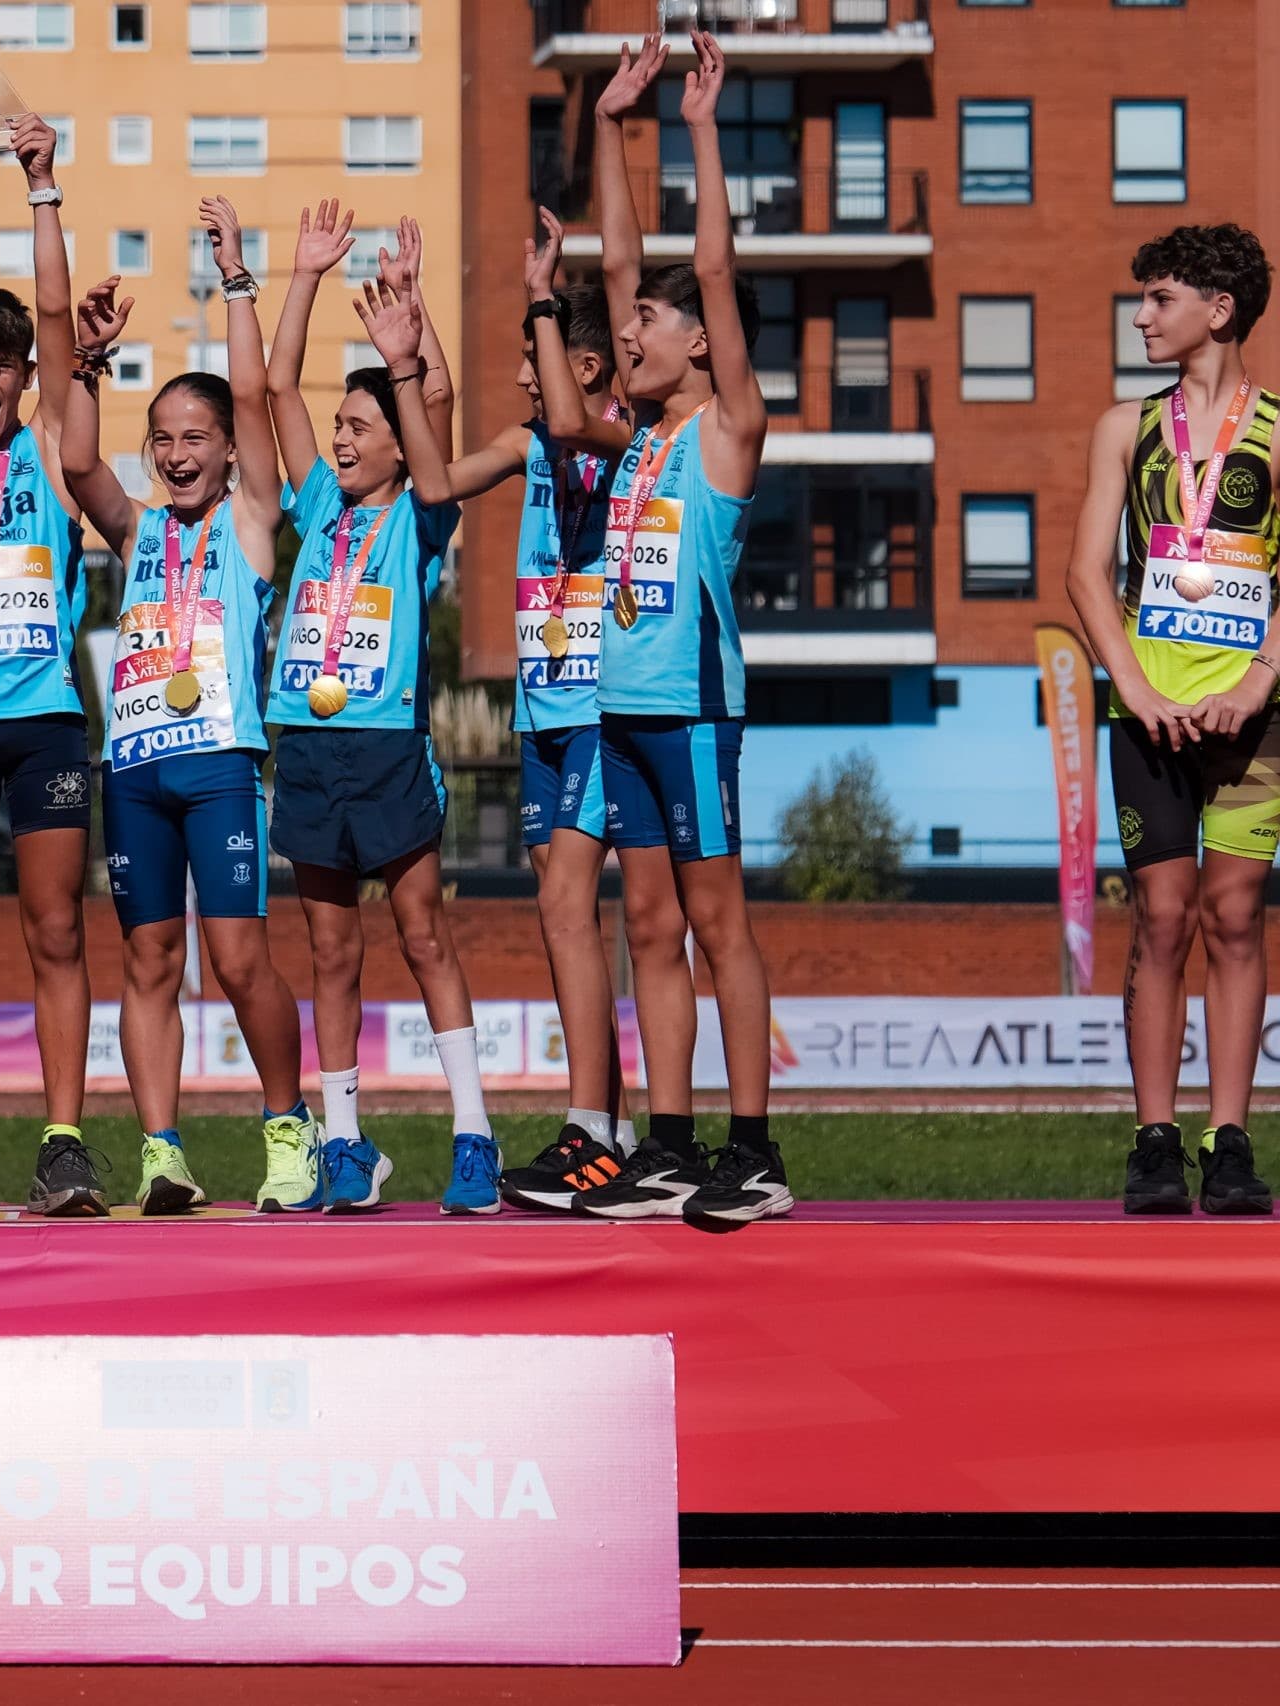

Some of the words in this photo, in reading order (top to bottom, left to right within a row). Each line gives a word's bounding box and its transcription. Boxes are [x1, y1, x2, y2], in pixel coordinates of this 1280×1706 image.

[1181, 451, 1197, 501] ATLETISMO
[1203, 452, 1224, 504] ATLETISMO
[633, 546, 669, 565] 026
[1202, 547, 1263, 566] TLETISMO
[0, 591, 49, 610] 2026
[185, 567, 202, 616] ATLETISMO
[340, 566, 362, 617] ATLETISMO
[1214, 579, 1263, 602] 2026
[290, 627, 321, 645] VIGO
[344, 631, 380, 650] 026
[566, 621, 601, 639] 202
[1168, 609, 1258, 645] Joma
[805, 1021, 958, 1069] RFEA
[87, 1459, 195, 1520] DE
[223, 1441, 557, 1521] ESPAÑA
[90, 1544, 467, 1620] EQUIPOS
